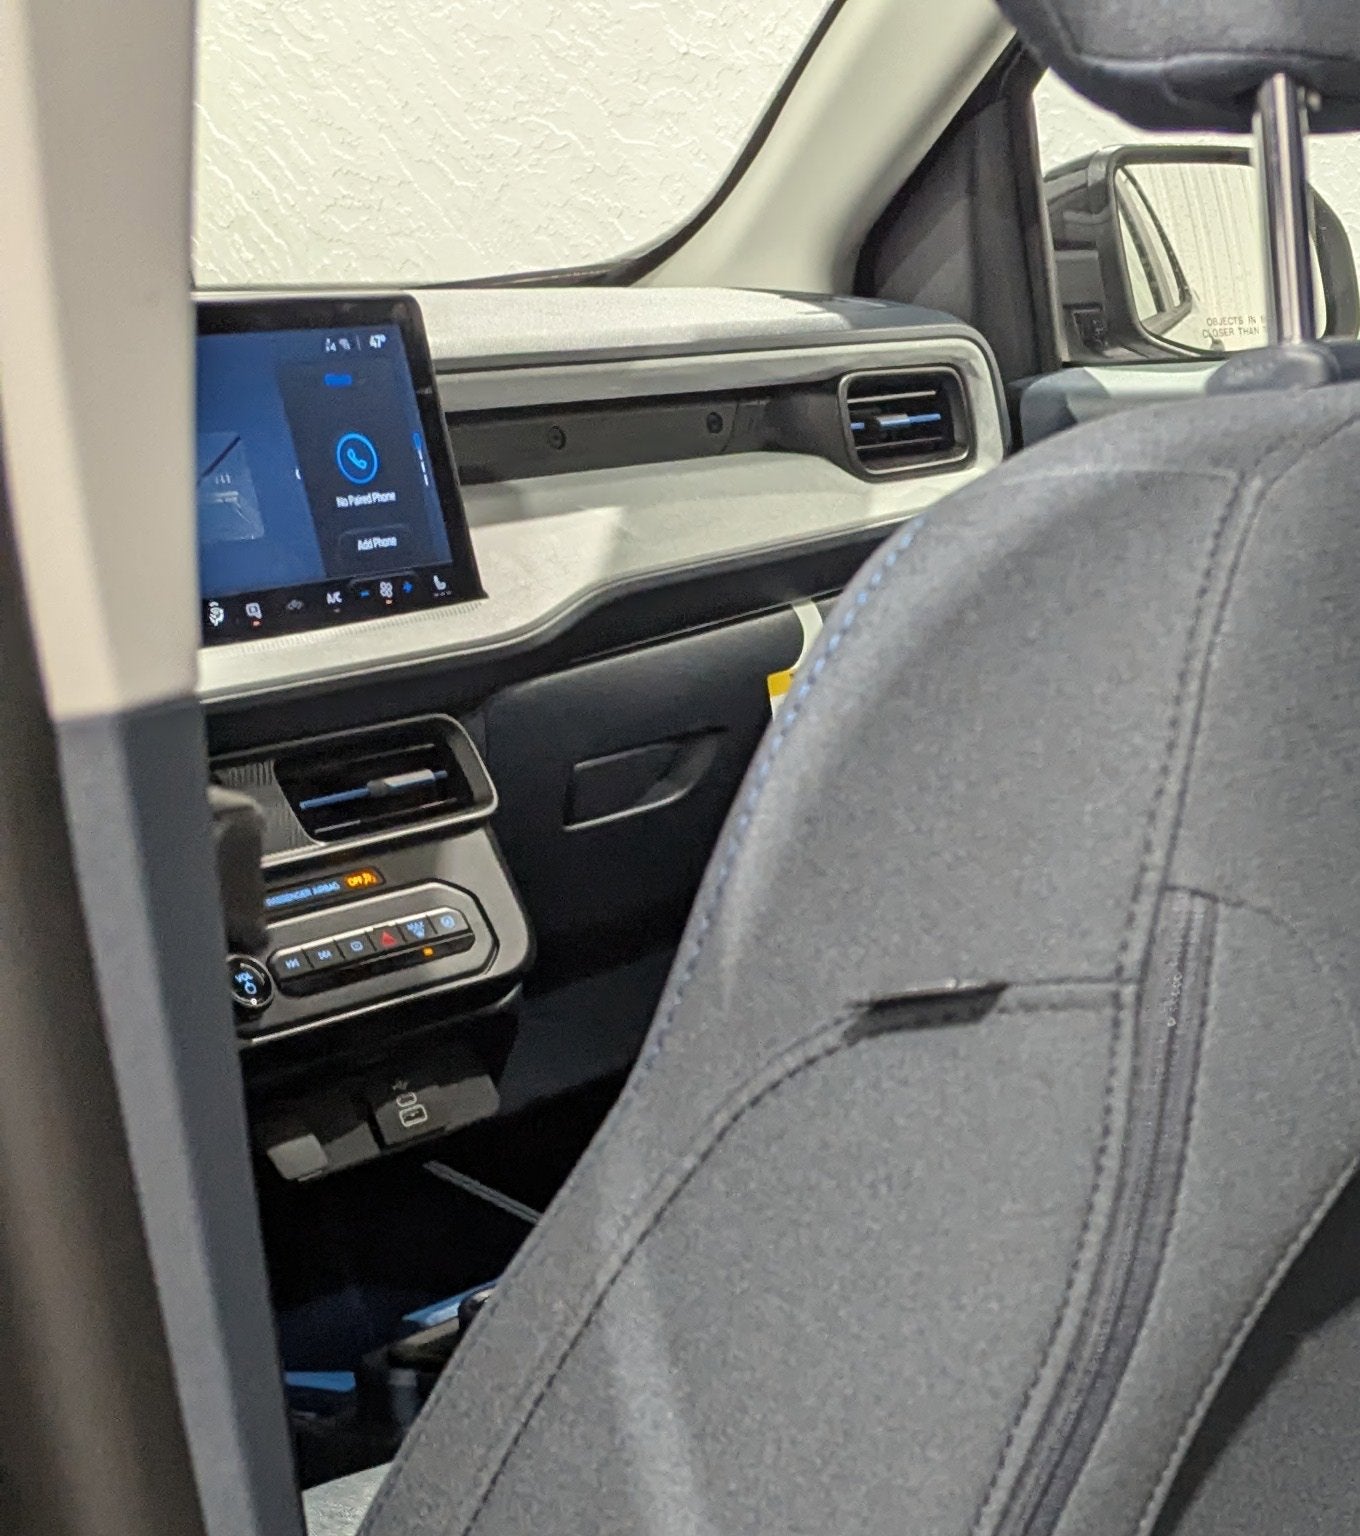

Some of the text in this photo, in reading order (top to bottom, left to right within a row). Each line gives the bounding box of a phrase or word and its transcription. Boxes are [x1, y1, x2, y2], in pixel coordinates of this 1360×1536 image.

[1206, 316, 1244, 326] OBJECTS
[1248, 314, 1257, 325] IN
[1238, 326, 1260, 335] THAN
[336, 496, 348, 509] No
[371, 490, 396, 505] Phone
[357, 535, 398, 551] Add Phone
[234, 971, 254, 983] VOL
